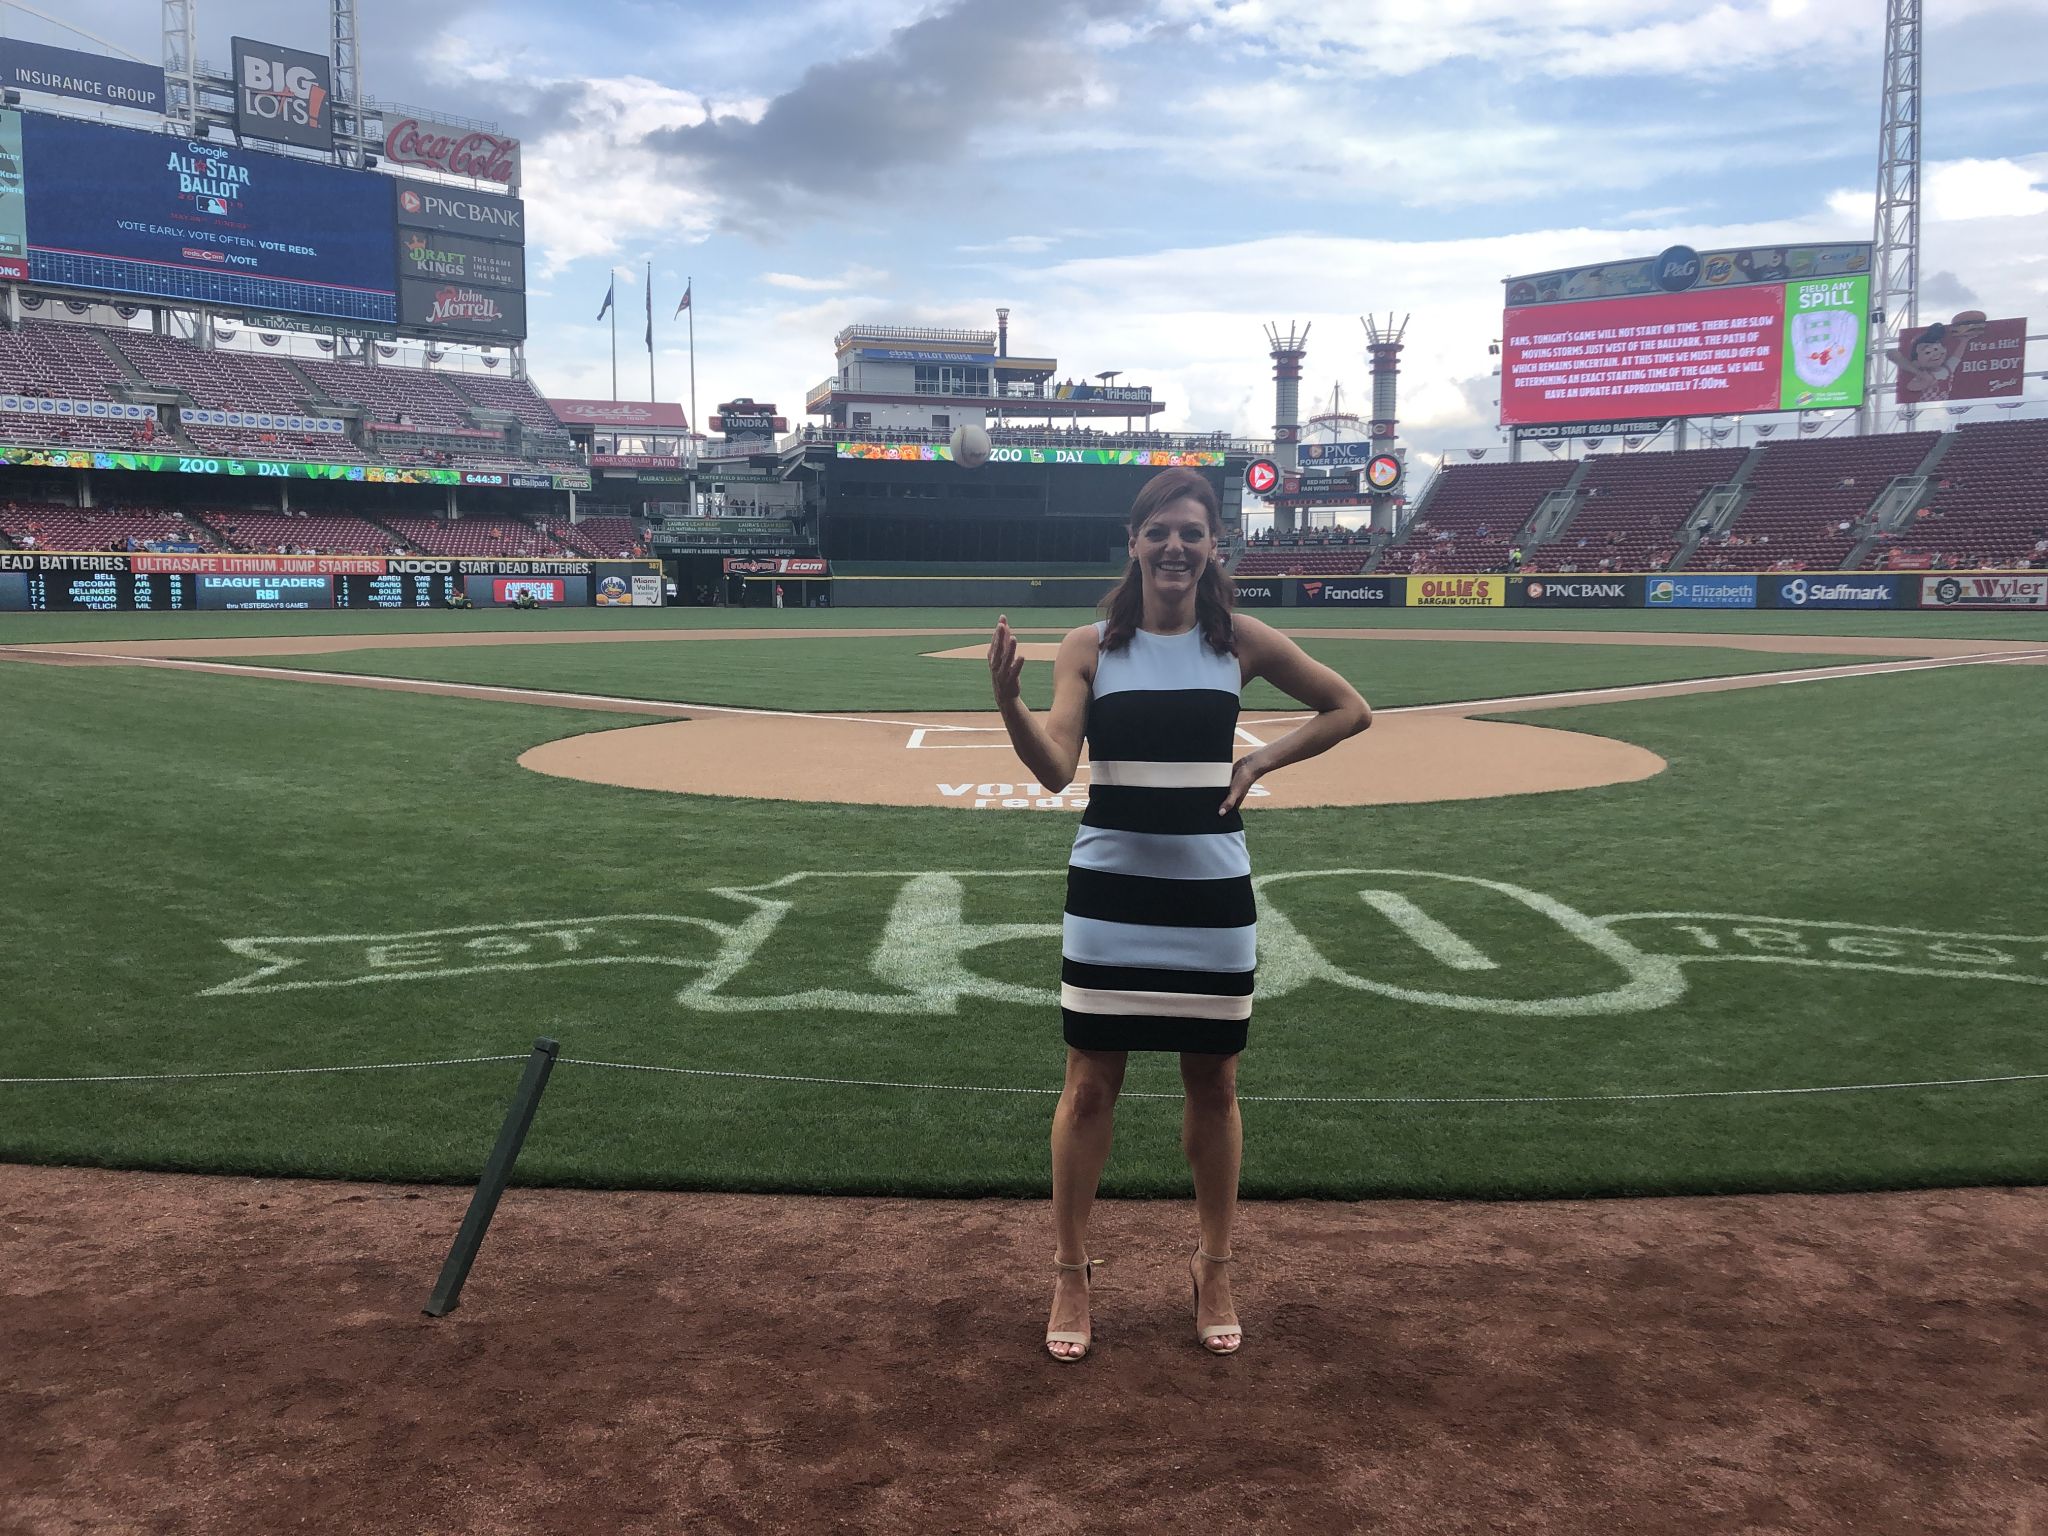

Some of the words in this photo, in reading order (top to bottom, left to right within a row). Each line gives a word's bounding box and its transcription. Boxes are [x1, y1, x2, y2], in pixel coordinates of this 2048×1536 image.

[243, 55, 319, 99] BIG
[15, 68, 102, 95] INSURANCE
[107, 84, 156, 104] GROUP
[188, 142, 229, 160] Google
[386, 118, 519, 183] Coca-Cola
[167, 152, 200, 175] ALL
[206, 159, 251, 186] STAR
[180, 174, 240, 199] BALLOT
[116, 219, 146, 232] VOTE
[150, 224, 185, 238] EARLY.
[188, 229, 216, 242] VOTE
[219, 234, 257, 248] OFTEN.
[259, 240, 286, 252] VOTE
[288, 244, 318, 257] REDS.
[409, 247, 466, 264] DRAFT
[417, 259, 465, 275] KINGS
[1663, 259, 1696, 280] P&G
[1705, 261, 1732, 281] Tide
[1800, 284, 1828, 293] FIELD
[1831, 281, 1855, 290] ANY
[453, 289, 482, 303] John
[1799, 291, 1854, 309] SPILL
[426, 297, 503, 322] Morrell
[248, 317, 310, 332] ULTIMATE
[313, 325, 333, 334] AIR
[337, 327, 393, 341] SHUTTLE
[1533, 331, 1574, 345] TONIGHT'S
[1574, 331, 1597, 341] GAME
[1598, 328, 1617, 339] WILL
[1619, 327, 1635, 337] NOT
[1636, 325, 1662, 336] START
[1663, 324, 1676, 334] ON
[1677, 322, 1700, 333] TIME.
[1702, 320, 1730, 331] THERE
[1730, 318, 1748, 328] ARE
[1749, 316, 1774, 326] SLOW
[1522, 349, 1552, 359] MOVING
[1553, 346, 1584, 357] STORMS
[1584, 344, 1604, 354] JUST
[1605, 342, 1627, 352] WEST
[1628, 342, 1639, 351] OF
[1640, 340, 1657, 350] THE
[1704, 335, 1722, 345] THE
[1722, 333, 1747, 344] PATH
[1748, 332, 1760, 342] OF
[1969, 341, 1986, 352] It's
[1998, 338, 2020, 350] Hit!
[1512, 363, 1537, 374] WHICH
[1538, 360, 1572, 372] REMAINS
[1622, 356, 1634, 366] AT
[1634, 355, 1653, 365] THIS
[1654, 353, 1676, 363] TIME
[1676, 352, 1689, 362] WE
[1690, 350, 1714, 360] MUST
[1714, 348, 1738, 359] HOLD
[1739, 347, 1756, 357] OFF
[1756, 346, 1770, 356] ON
[1962, 360, 1987, 373] BIG
[1990, 357, 2020, 371] BOY
[1514, 375, 1568, 388] DETERMINING
[1568, 374, 1580, 384] AN
[1581, 372, 1606, 383] EXACT
[1606, 370, 1645, 382] STARTING
[1648, 368, 1668, 378] TIME
[1668, 367, 1681, 377] OF
[1681, 366, 1698, 376] THE
[1699, 364, 1726, 375] GAME.
[1727, 363, 1741, 373] WE
[1742, 361, 1765, 372] WILL
[1105, 388, 1150, 400] TriHealth
[1544, 389, 1566, 400] HAVE
[1567, 388, 1579, 398] AN
[1580, 386, 1610, 397] UPDATE
[1612, 385, 1622, 395] AT
[1623, 380, 1692, 394] APPROXIMATELY
[565, 404, 652, 418] Reds
[725, 418, 769, 428] TUNDRA
[1517, 427, 1560, 438] NOCO
[1561, 425, 1587, 435] START
[1588, 424, 1612, 434] DEAD
[989, 448, 1022, 462] ZOO
[1056, 450, 1084, 463] DAY
[1324, 444, 1358, 458] PNC
[178, 457, 219, 474] ZOO
[257, 463, 290, 478] DAY
[652, 458, 676, 467] PATIO
[466, 474, 502, 484] 6:44:39
[563, 479, 588, 488] Evans
[138, 557, 216, 572] ULTRASAFE
[223, 558, 276, 572] LITHIUM
[280, 559, 316, 573] JUMP
[319, 560, 383, 574] STARTERS.
[389, 560, 451, 574] NOCO
[459, 561, 495, 574] START
[500, 562, 528, 574] DEAD
[532, 562, 592, 574] BATTERIES.
[205, 578, 261, 588] LEAGUE
[264, 578, 326, 588] LEADERS
[505, 582, 554, 591] AMERICAN
[1674, 585, 1690, 597] St.
[1692, 584, 1752, 597] Elizabeth
[1942, 586, 1954, 596] 45
[1972, 578, 2044, 599] Wyler
[256, 590, 279, 600] RBI
[505, 590, 554, 601] LEGUE
[1233, 588, 1271, 598] OYOTA
[1325, 586, 1384, 600] Fanatics
[1809, 584, 1890, 600] Staffmark
[936, 783, 1090, 796] VOTE
[1673, 926, 2017, 965] 1869
